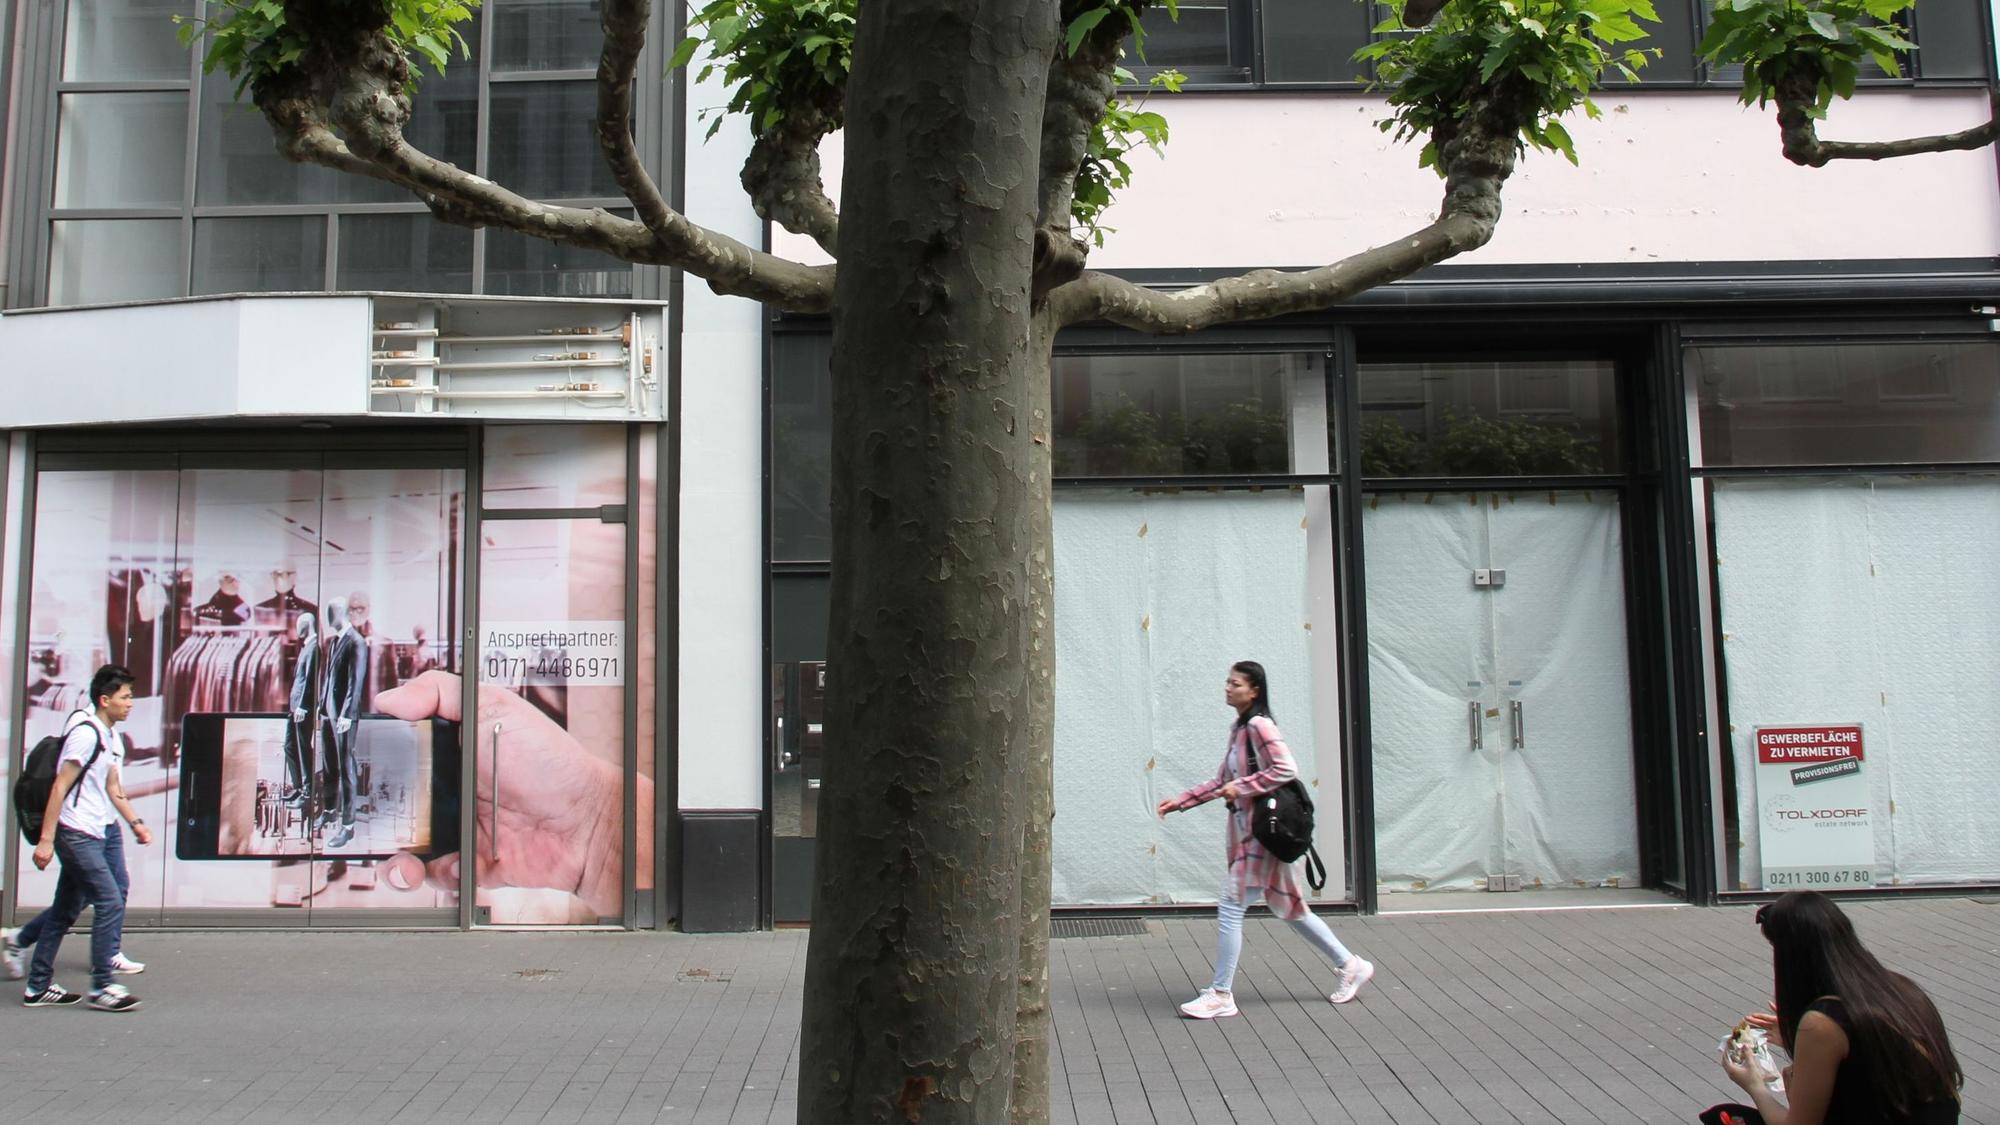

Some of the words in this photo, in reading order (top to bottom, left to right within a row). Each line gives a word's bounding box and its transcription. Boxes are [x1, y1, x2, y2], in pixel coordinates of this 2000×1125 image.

[488, 630, 618, 650] Ansprechpartner:
[488, 657, 618, 678] 0171-4486971
[1760, 731, 1857, 744] GEWERBEFLÄCHE
[1770, 747, 1784, 758] ZU
[1788, 746, 1850, 757] VERMIETEN
[1794, 761, 1856, 780] PROVISIONSFREI
[1777, 809, 1868, 820] TOLXDORF
[1770, 873, 1800, 884] 0211
[1806, 872, 1829, 883] 300
[1834, 871, 1849, 882] 67
[1854, 871, 1869, 882] 80
